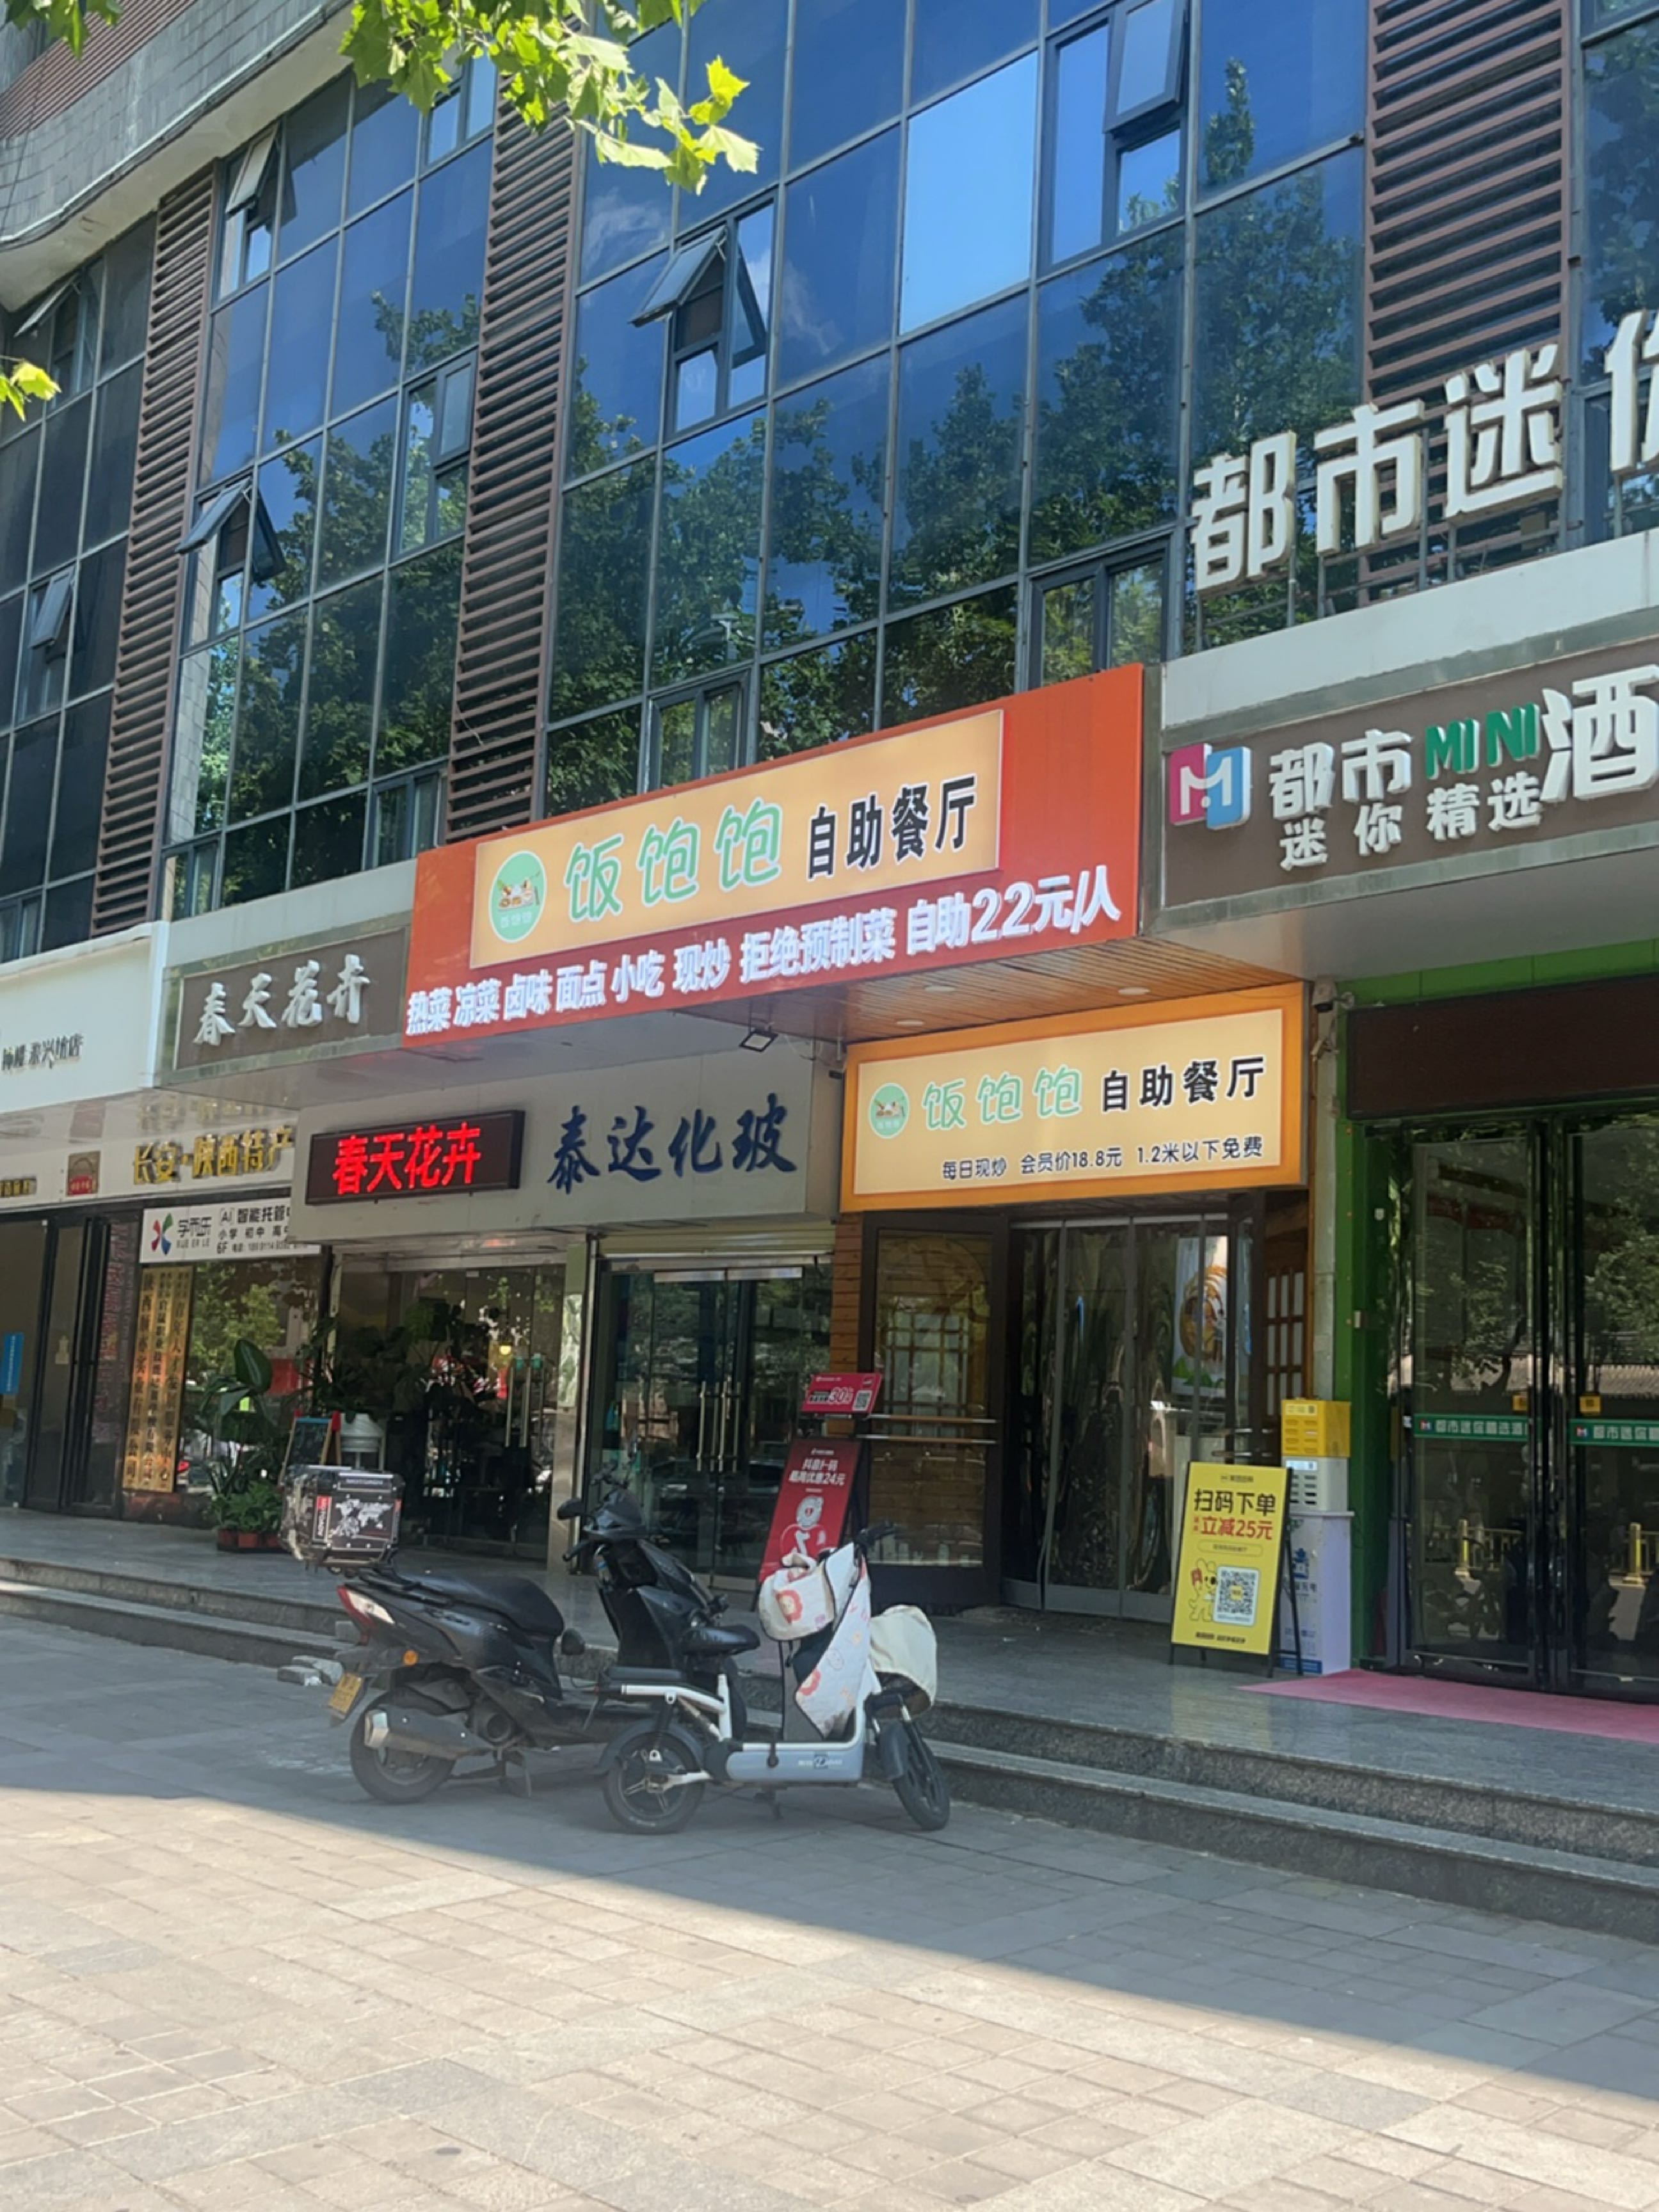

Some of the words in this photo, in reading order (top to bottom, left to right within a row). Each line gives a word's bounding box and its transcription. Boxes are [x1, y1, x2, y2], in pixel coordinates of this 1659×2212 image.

[1425, 702, 1541, 780] MINI
[565, 797, 783, 922] 饭饱饱
[806, 774, 977, 881] 自助餐厅
[406, 990, 452, 1036] 热菜
[453, 978, 501, 1025] 凉菜
[503, 970, 553, 1021] 卤味
[556, 960, 607, 1012] 面点
[611, 950, 665, 1002] 小吃
[673, 939, 731, 993] 现炒
[739, 908, 898, 984] 拒绝预制菜
[921, 1065, 1082, 1131] 饭饱饱
[1102, 1055, 1265, 1113] 自助餐厅
[332, 1121, 481, 1195] 春天花卉
[548, 1094, 797, 1194] 泰达化玻
[942, 1157, 1007, 1180] 每日现炒
[1020, 1147, 1123, 1174] 会员价18.8元
[1137, 1135, 1263, 1164] 1.2米以下免费
[1194, 1489, 1276, 1516] 扫码下单
[1201, 1516, 1273, 1541] 立减25元
